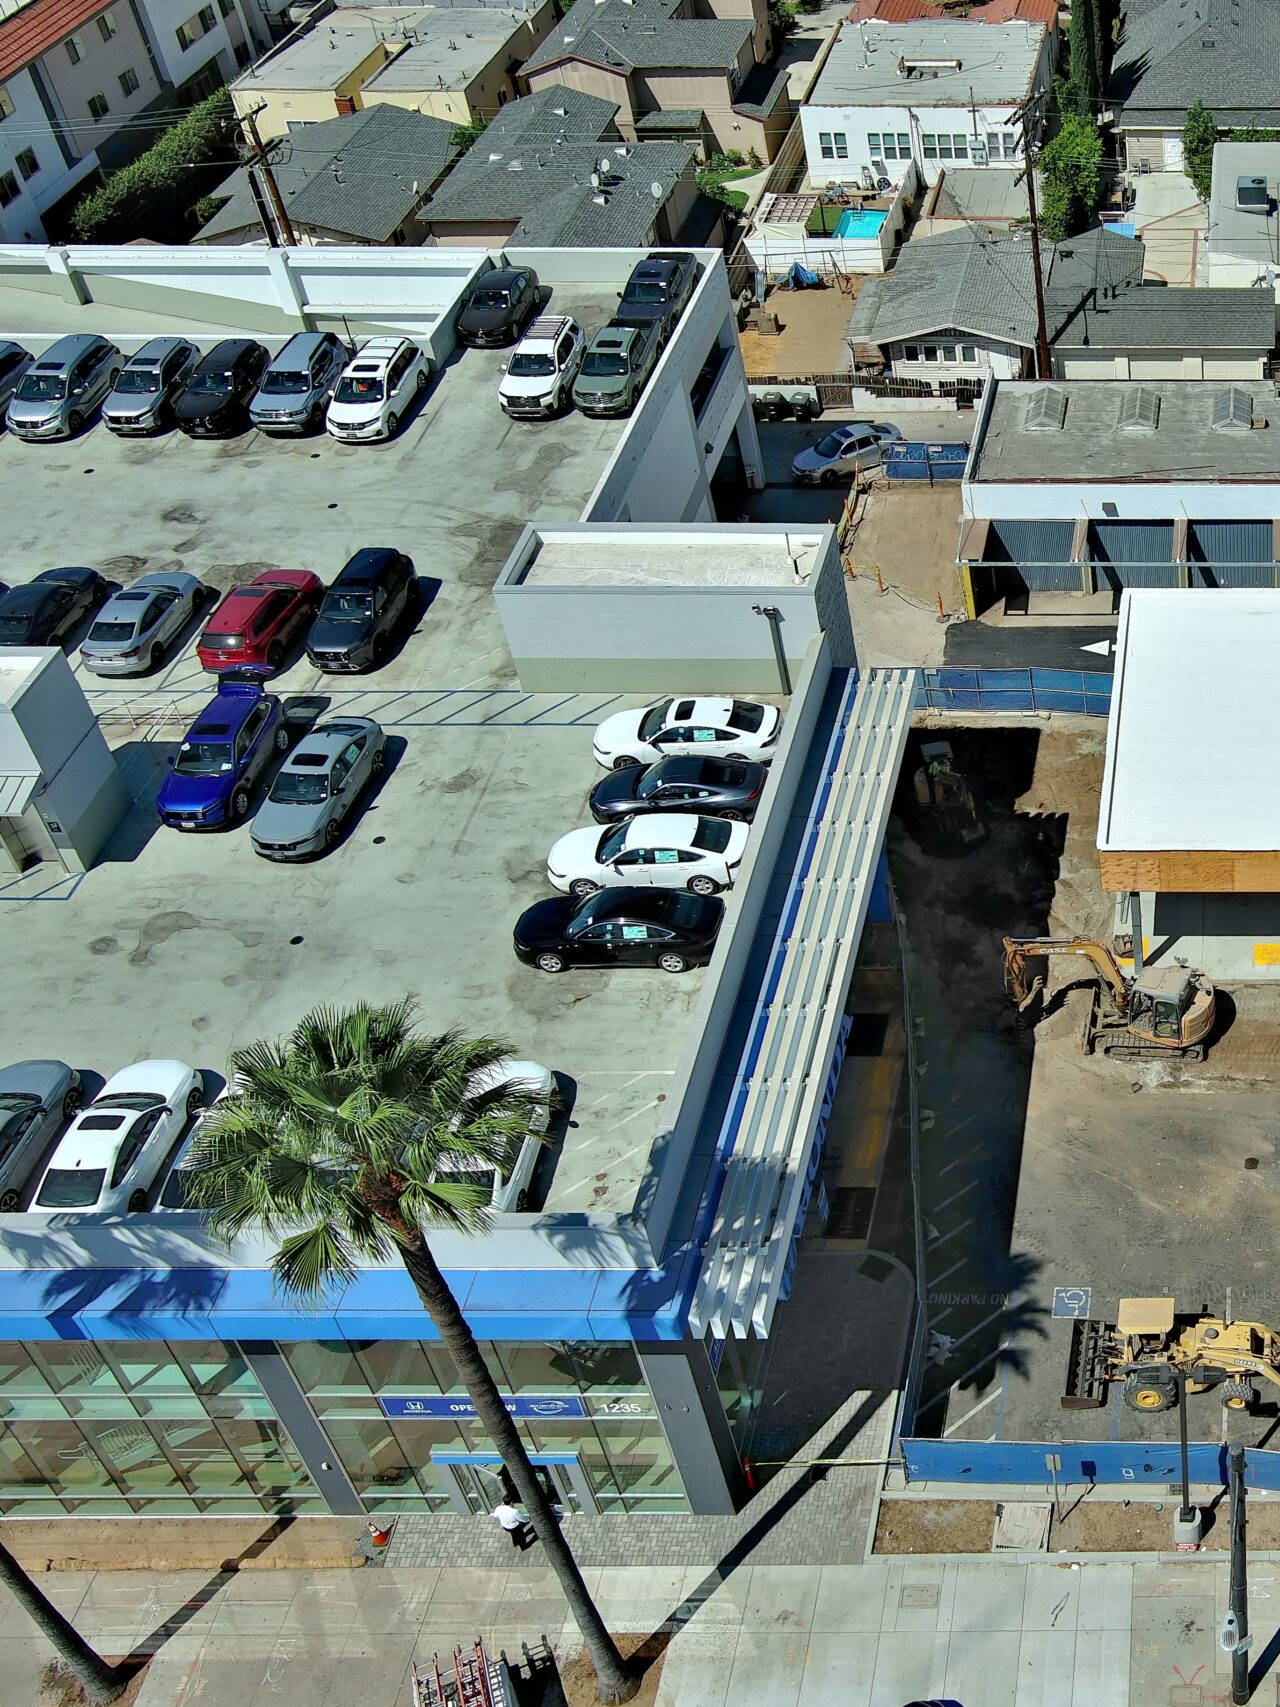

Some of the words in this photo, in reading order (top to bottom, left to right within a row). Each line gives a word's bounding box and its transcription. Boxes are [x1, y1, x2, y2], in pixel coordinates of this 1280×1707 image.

[929, 1293, 986, 1305] PARKING
[990, 1293, 1010, 1305] NO
[600, 1403, 642, 1413] 1235
